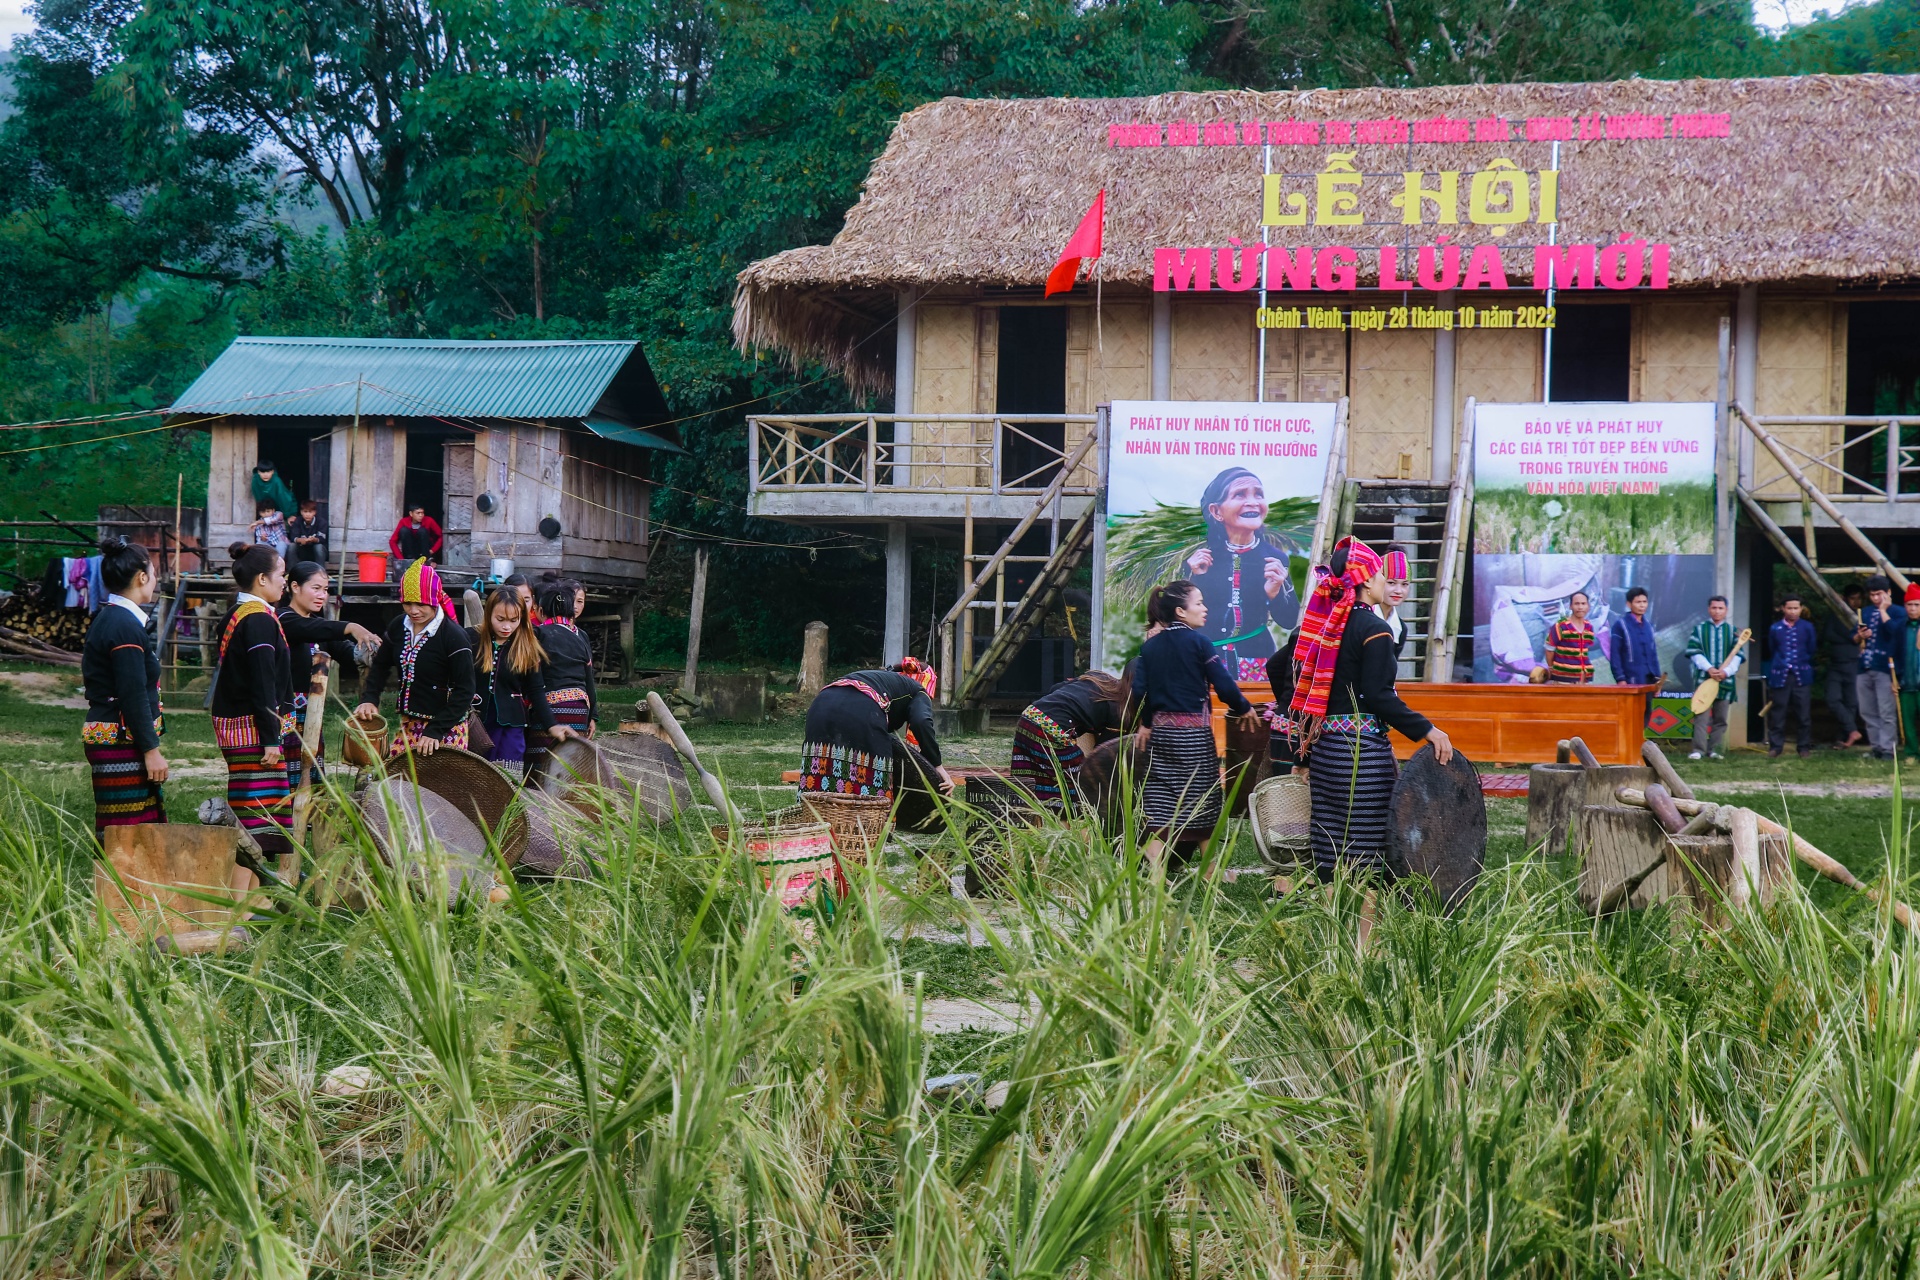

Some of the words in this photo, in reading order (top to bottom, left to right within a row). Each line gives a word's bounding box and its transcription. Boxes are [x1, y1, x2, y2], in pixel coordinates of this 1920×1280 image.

[1325, 120, 1351, 144] TIN
[1261, 151, 1364, 226] LỄ
[1390, 157, 1560, 237] HỘI
[1153, 237, 1357, 292] MỪNG
[1378, 235, 1509, 291] LÚA
[1532, 232, 1670, 290] MỚI
[1256, 307, 1301, 328] Chênh
[1307, 306, 1346, 331] Vênh,
[1350, 307, 1386, 331] ngày
[1389, 306, 1408, 328] 28
[1412, 306, 1454, 330] tháng
[1459, 306, 1475, 328] 10
[1480, 305, 1513, 328] năm
[1517, 306, 1556, 328] 2022
[1130, 414, 1162, 431] PHÁT
[1165, 417, 1190, 431] HUY
[1194, 414, 1230, 432] NHÂN
[1234, 413, 1250, 432] TỐ
[1253, 415, 1281, 433] TÍCH
[1285, 417, 1315, 436] CỰC,
[1525, 418, 1552, 435] BẢO
[1557, 419, 1572, 437] VỆ
[1577, 418, 1593, 434] VÀ
[1598, 417, 1632, 434] PHÁT
[1637, 420, 1663, 433] HUY
[1125, 438, 1161, 455] NHÂN
[1165, 438, 1190, 455] VĂN
[1194, 441, 1236, 456] TRONG
[1240, 440, 1260, 456] TÍN
[1264, 439, 1318, 458] NGƯỠNG
[1490, 439, 1516, 455] CÁC
[1521, 439, 1542, 455] GIÁ
[1547, 441, 1568, 457] TRỊ
[1572, 437, 1595, 454] TỐT
[1600, 441, 1625, 457] ĐẸP
[1662, 438, 1699, 454] VỮNG
[1519, 461, 1563, 475] TRONG
[1624, 457, 1668, 474] THỐNG
[1527, 479, 1554, 495] VĂN
[1558, 478, 1586, 495] HÓA
[1589, 478, 1618, 497] VIỆT
[1622, 481, 1660, 495] NAM!
